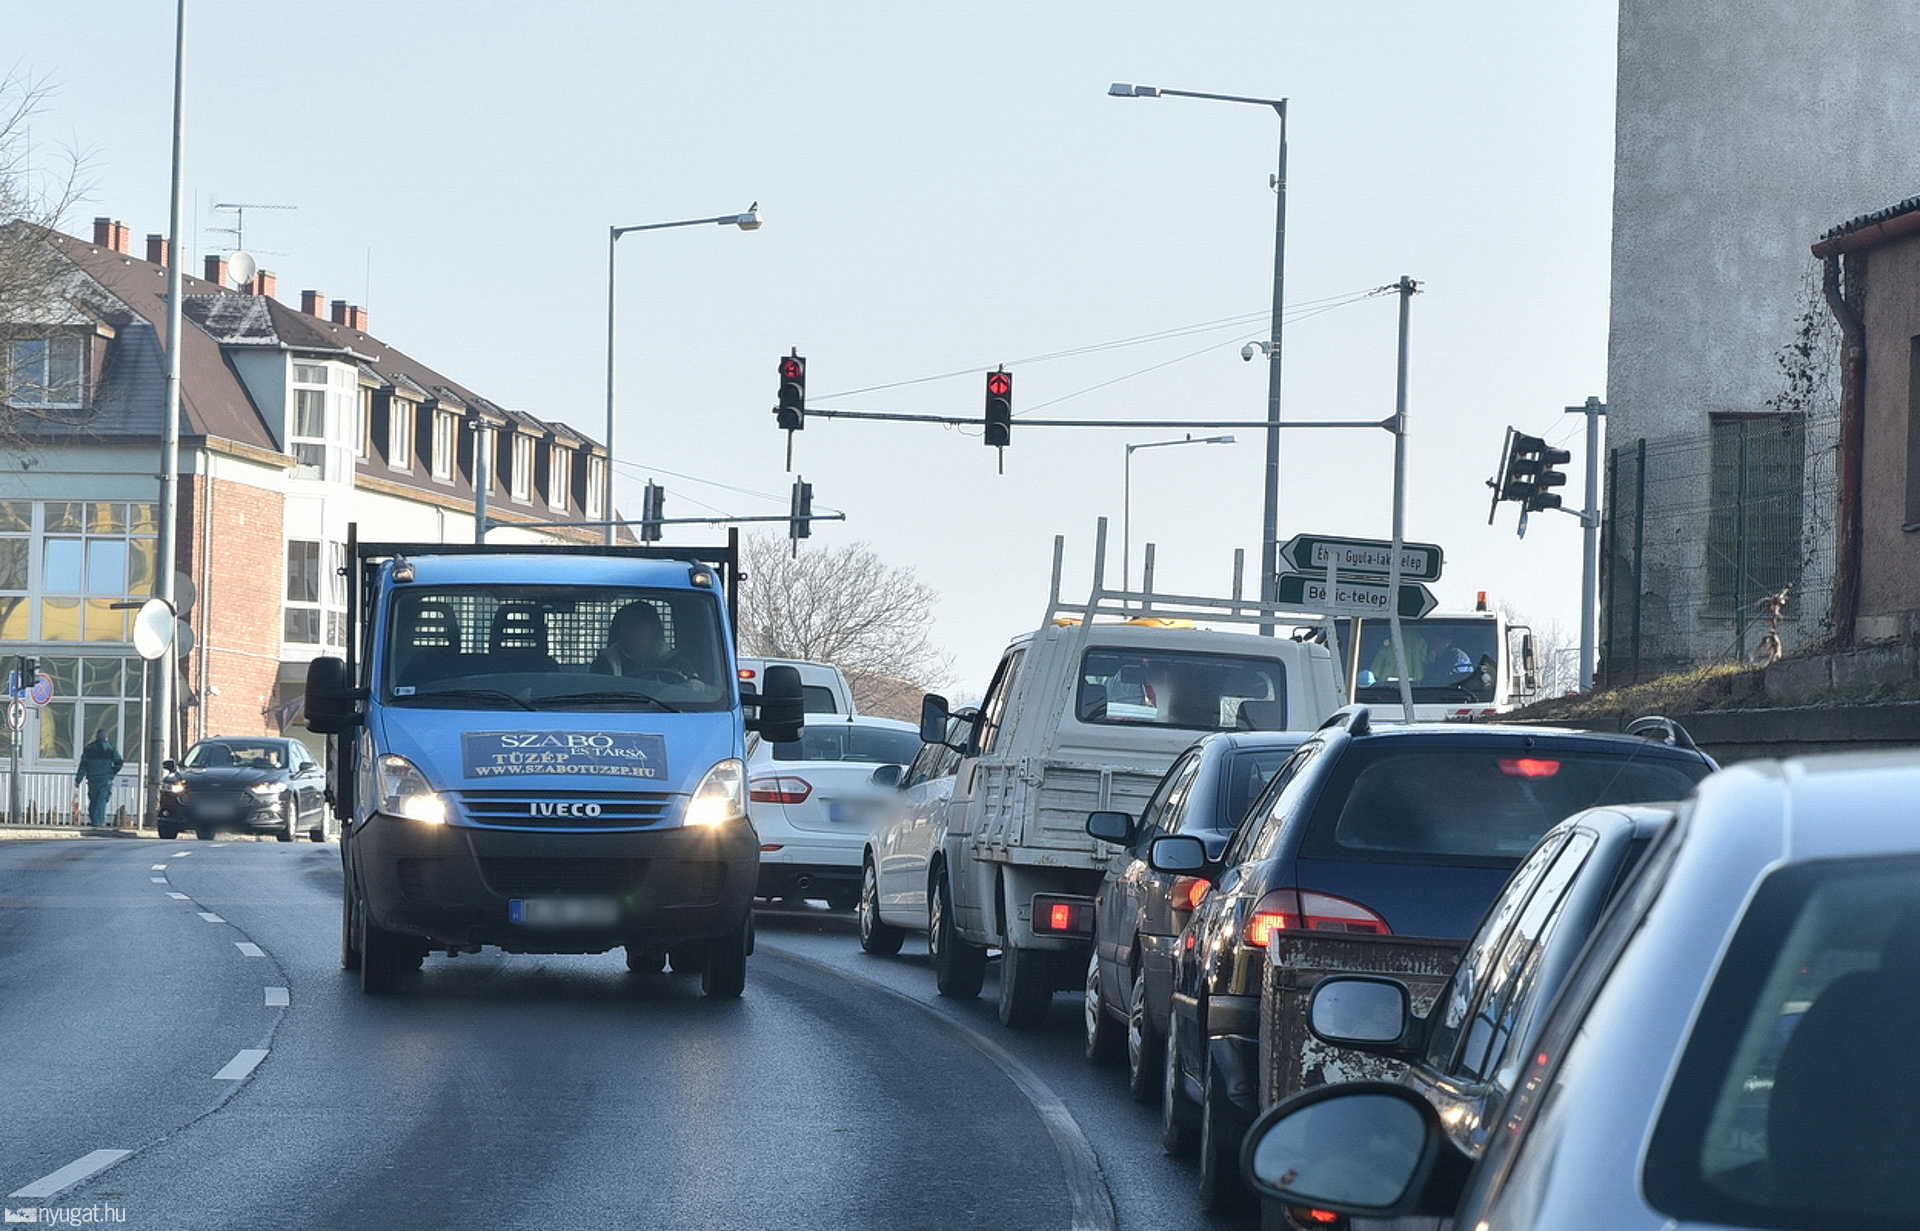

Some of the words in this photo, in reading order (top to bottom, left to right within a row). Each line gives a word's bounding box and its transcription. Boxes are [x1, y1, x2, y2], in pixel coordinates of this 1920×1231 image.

[1317, 544, 1341, 562] Éhn
[1345, 550, 1422, 571] Gyula-lakelep
[1308, 586, 1388, 608] Béic-telep
[501, 732, 614, 748] SZABÓ
[475, 764, 656, 777] WWW.SZABOTUZEP.HU
[530, 803, 601, 817] IVECO
